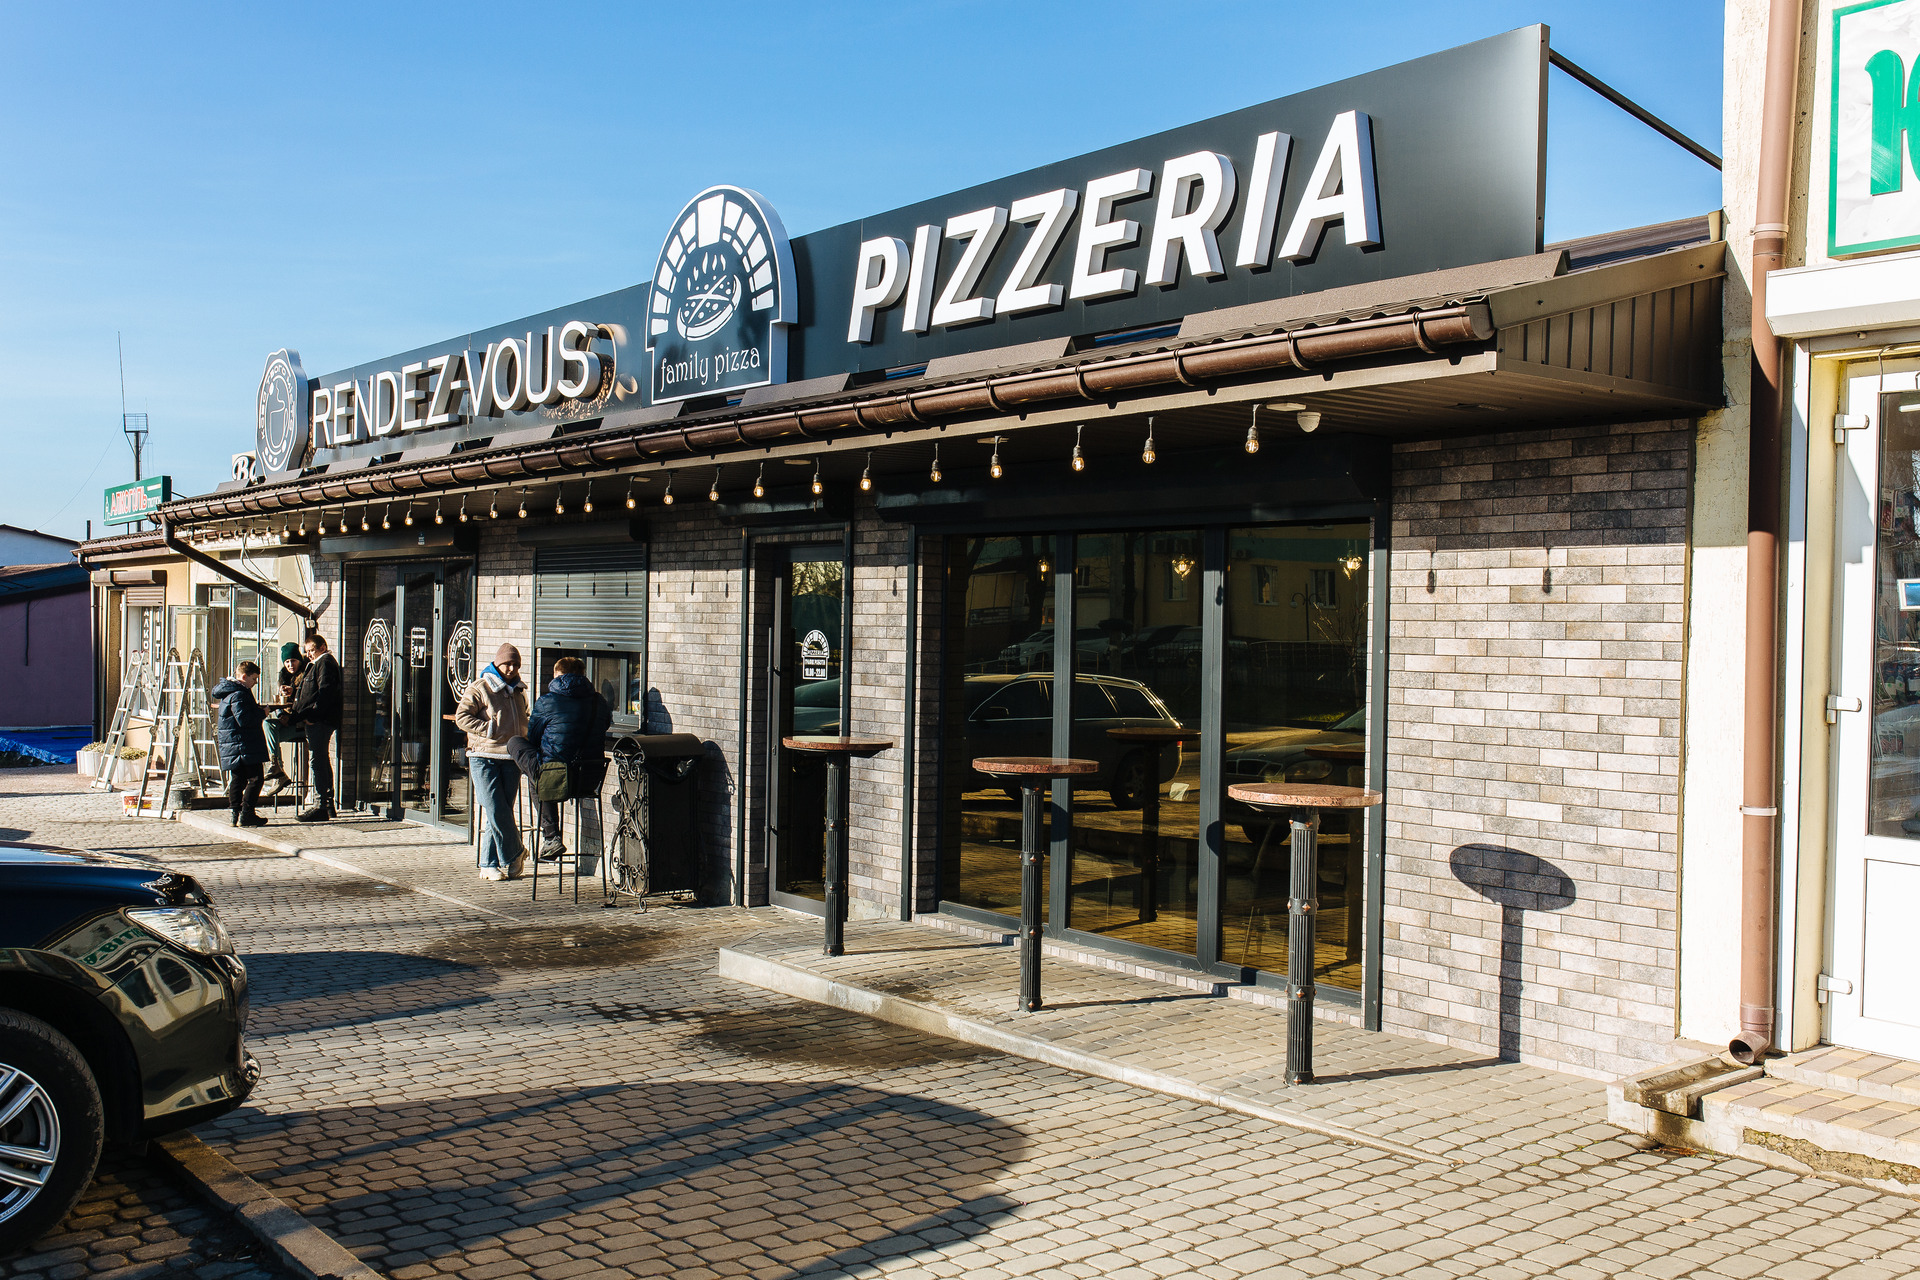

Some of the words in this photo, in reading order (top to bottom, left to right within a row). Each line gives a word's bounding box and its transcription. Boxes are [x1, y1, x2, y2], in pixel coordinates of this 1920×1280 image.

[847, 109, 1379, 343] PIZZERIA
[313, 320, 600, 449] RENDEZ-VOUS
[660, 351, 709, 393] family
[714, 346, 760, 384] pizza
[110, 486, 148, 516] АЛКОГОЛЬ
